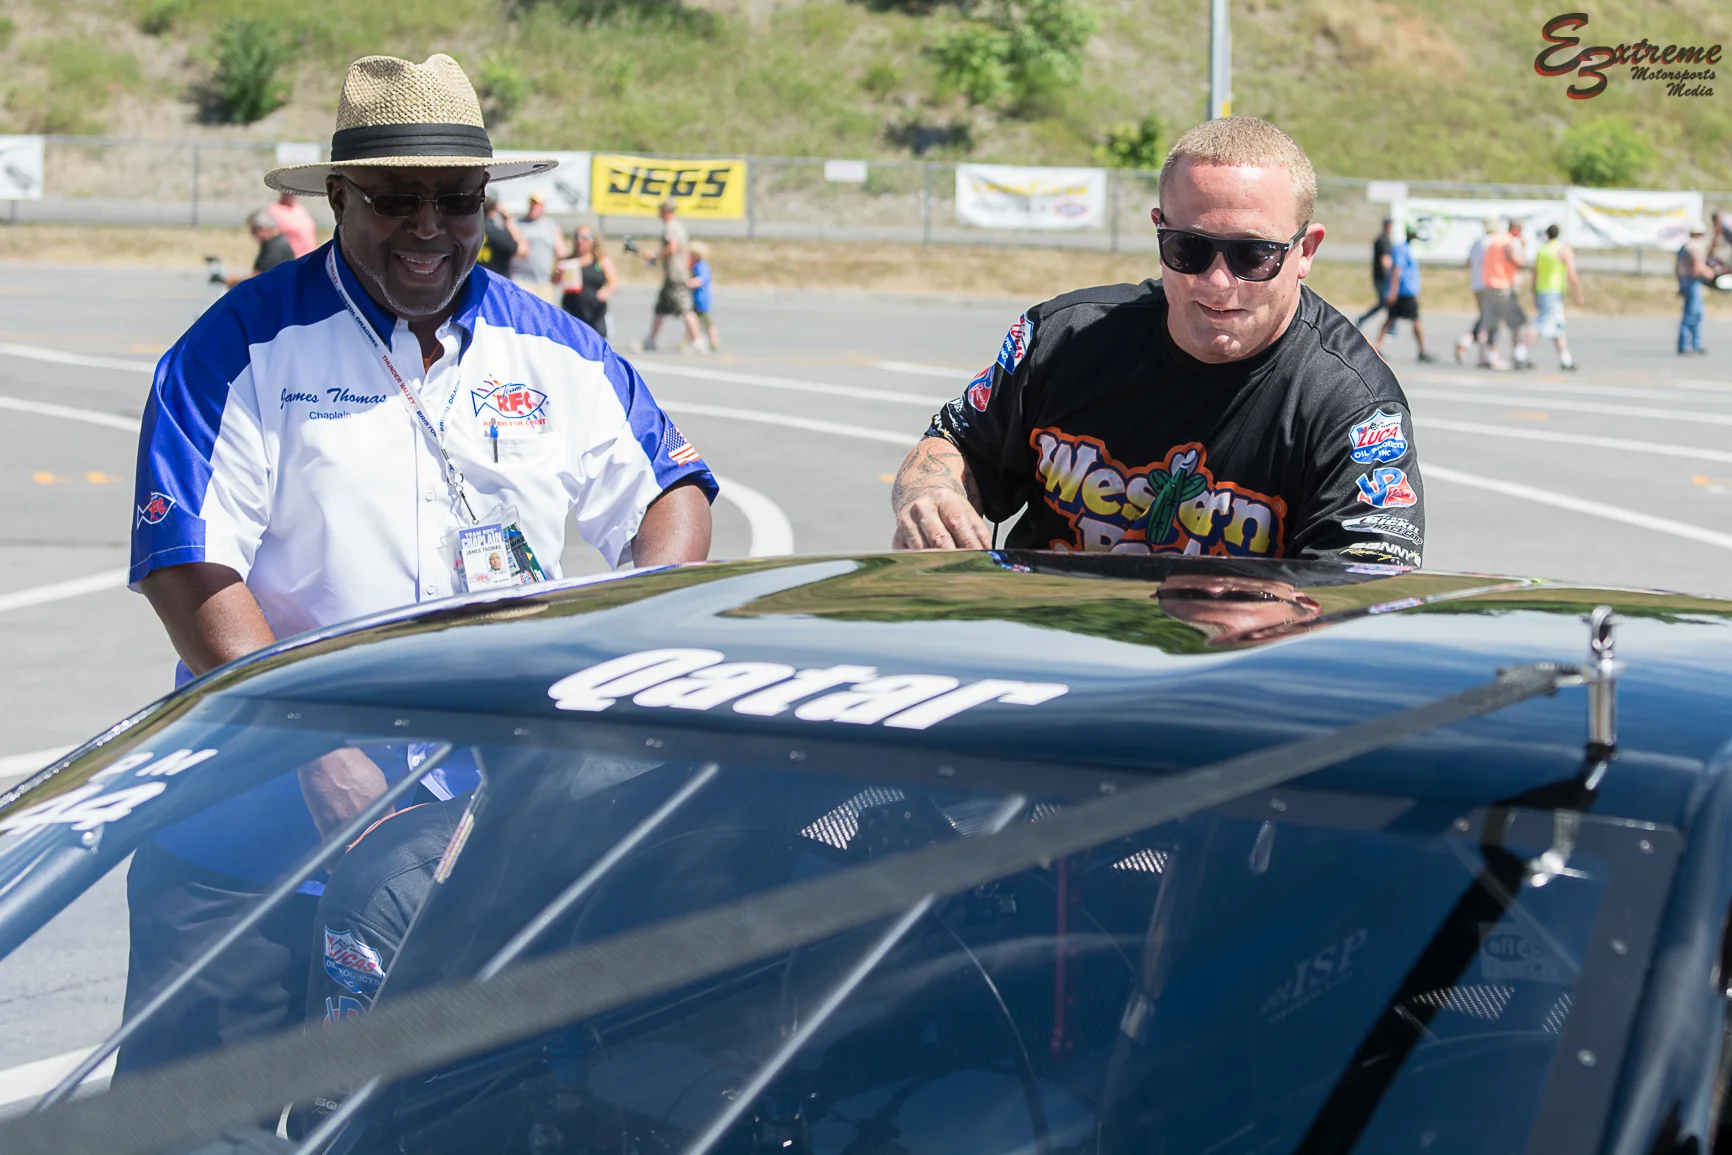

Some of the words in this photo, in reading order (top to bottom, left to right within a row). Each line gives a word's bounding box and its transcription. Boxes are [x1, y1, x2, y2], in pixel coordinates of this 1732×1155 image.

[608, 167, 731, 198] JEGS
[338, 289, 356, 317] BRISTOL
[382, 354, 403, 383] THUNDER
[399, 382, 416, 406] VALLEY
[280, 387, 320, 410] James
[326, 387, 389, 404] Thomas
[309, 411, 352, 421] Chaplain
[1357, 426, 1399, 448] LUCA
[1353, 450, 1371, 459] OIL
[1379, 449, 1392, 457] INC
[461, 531, 503, 550] CHAPLAIN
[466, 548, 482, 556] JAMES
[482, 544, 502, 553] THOMAS
[547, 647, 1070, 730] Qatar
[326, 959, 337, 970] OIL
[338, 966, 381, 986] RODUCTS
